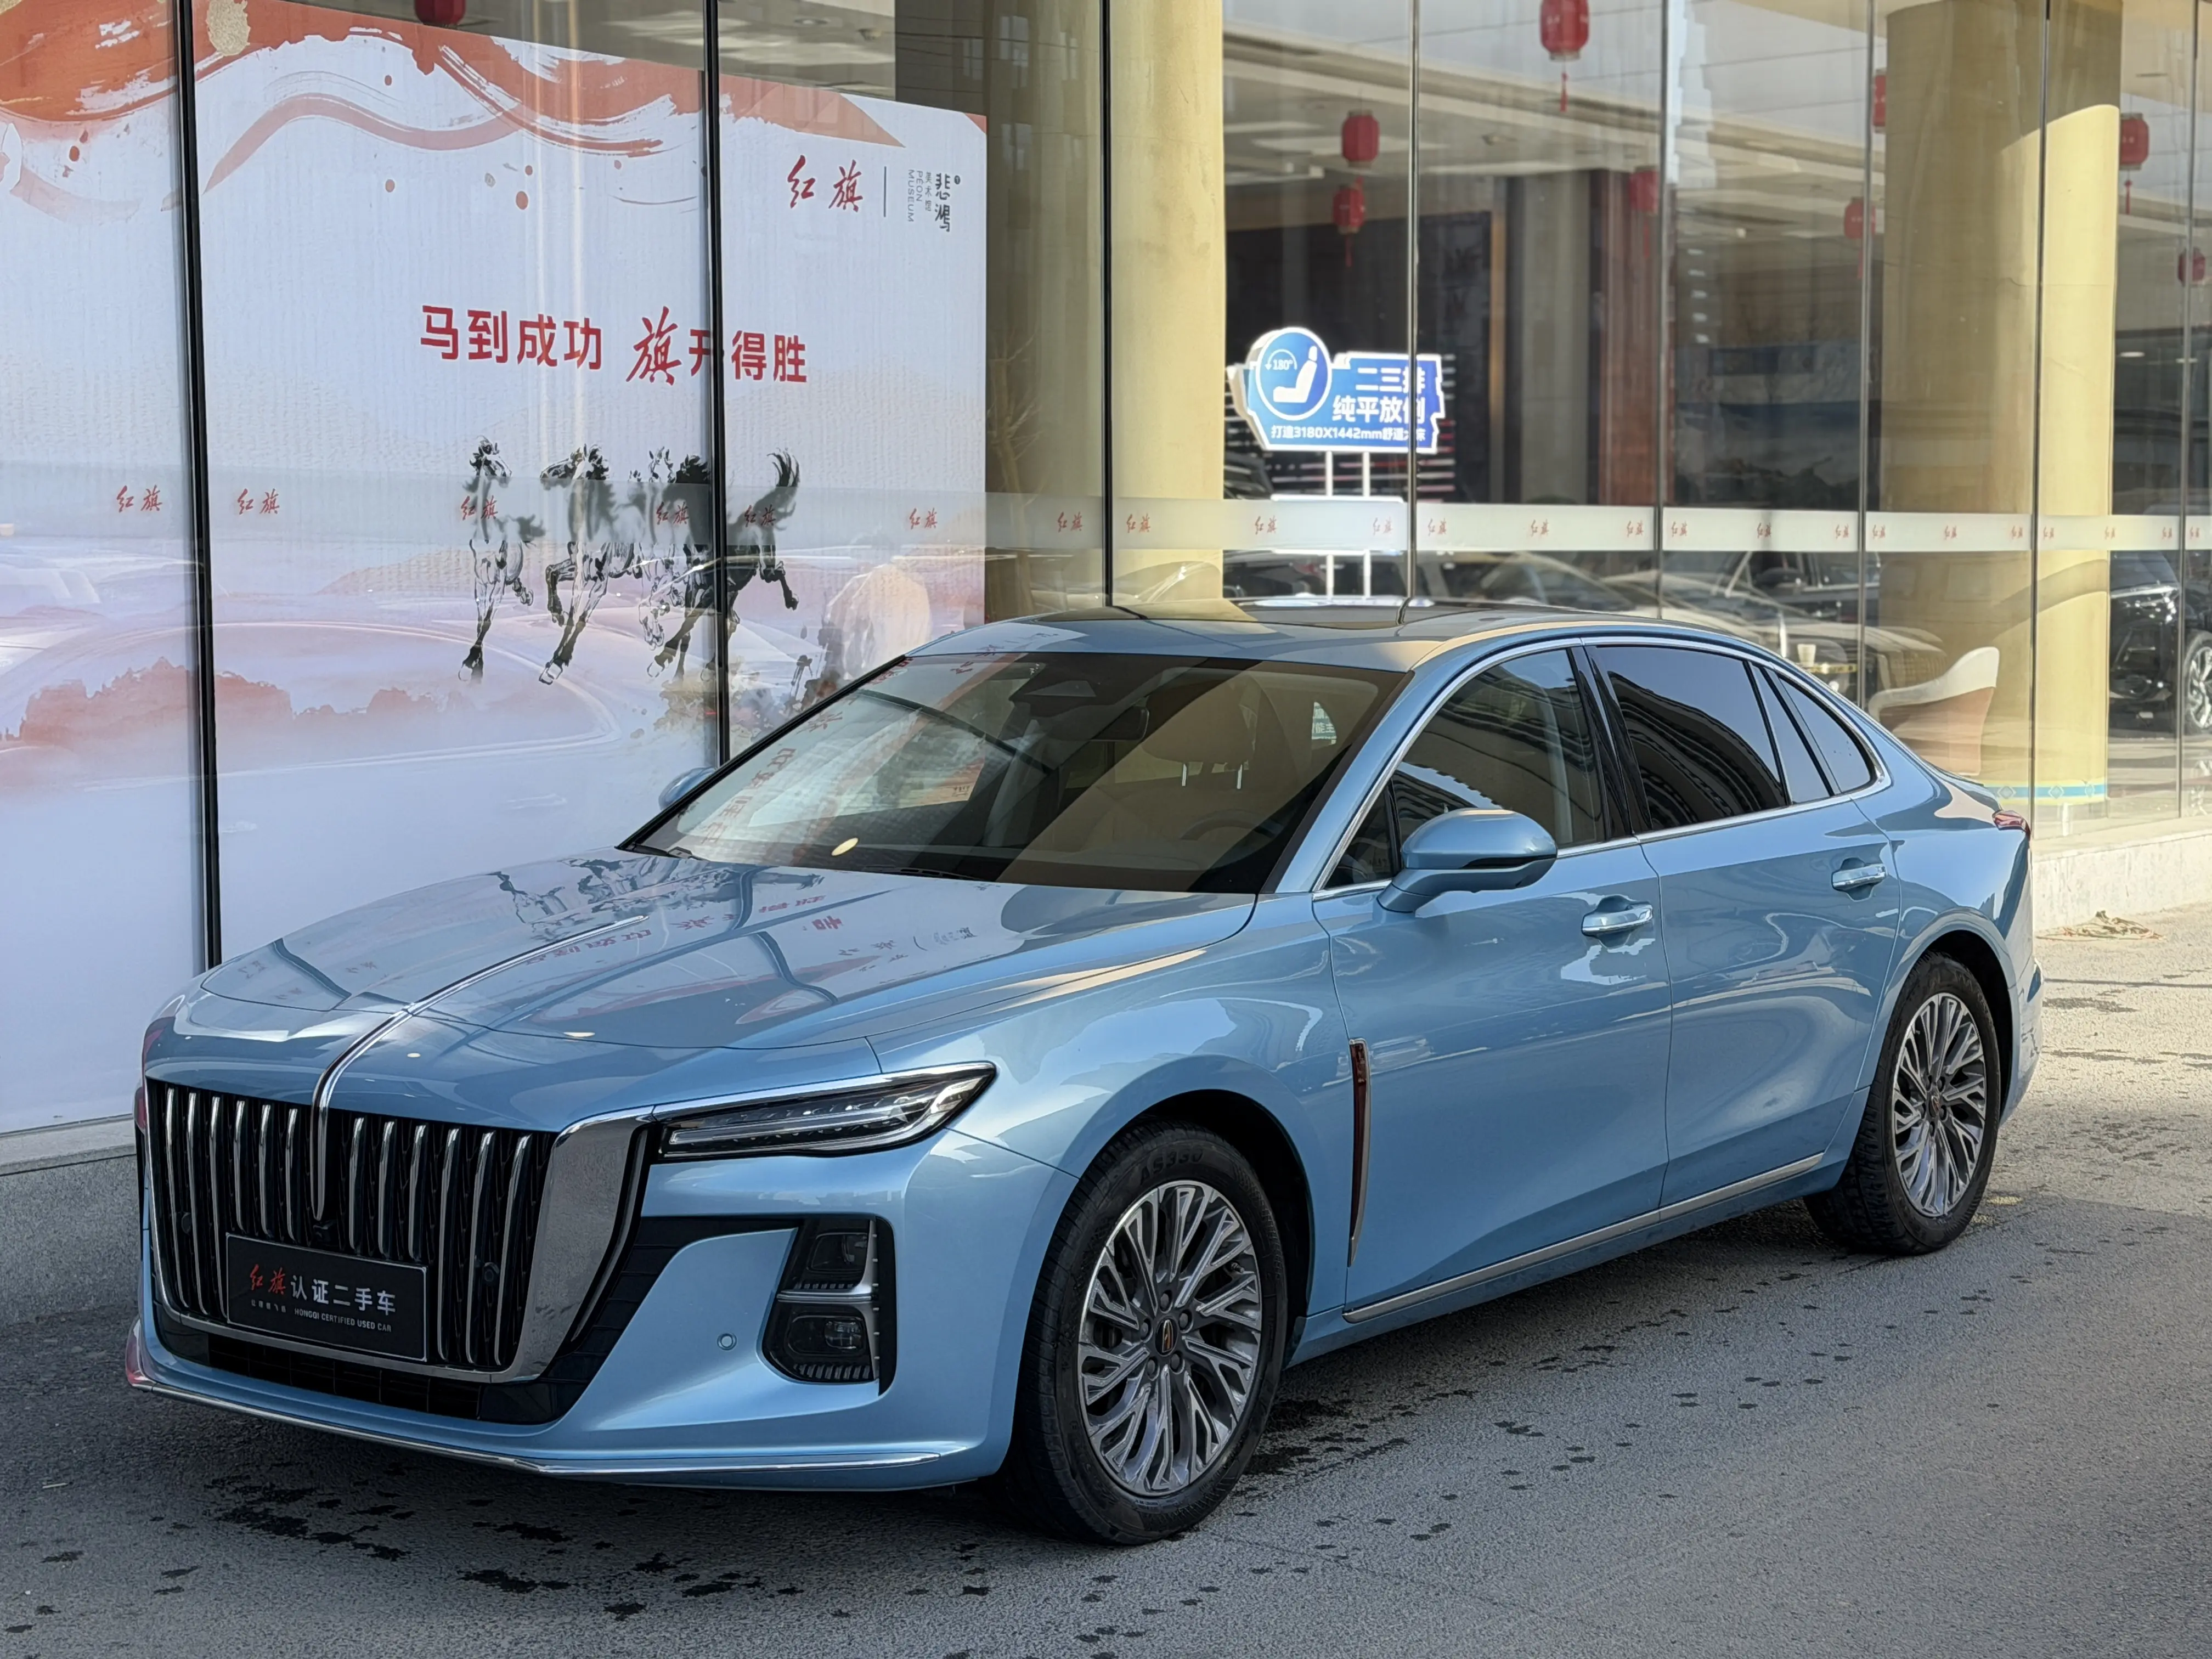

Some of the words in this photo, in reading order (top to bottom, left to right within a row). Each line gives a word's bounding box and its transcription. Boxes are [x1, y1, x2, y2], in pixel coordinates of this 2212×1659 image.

[787, 155, 863, 212] 红旗
[420, 304, 602, 370] 马到成功
[117, 484, 162, 513] 红旗
[237, 488, 280, 515] 红旗
[461, 495, 498, 521] 红旗
[656, 501, 689, 524] 红旗
[744, 504, 776, 527] 红旗
[909, 507, 938, 529] 红旗
[1058, 511, 1083, 533] 红旗
[1126, 514, 1150, 533] 红旗
[1255, 515, 1277, 535] 红旗
[250, 1263, 396, 1316] 红旗认证二手车
[295, 1308, 320, 1319] HONGQI
[321, 1313, 356, 1326] CERTIFIED
[357, 1319, 375, 1330] USED
[377, 1323, 392, 1333] CAR
